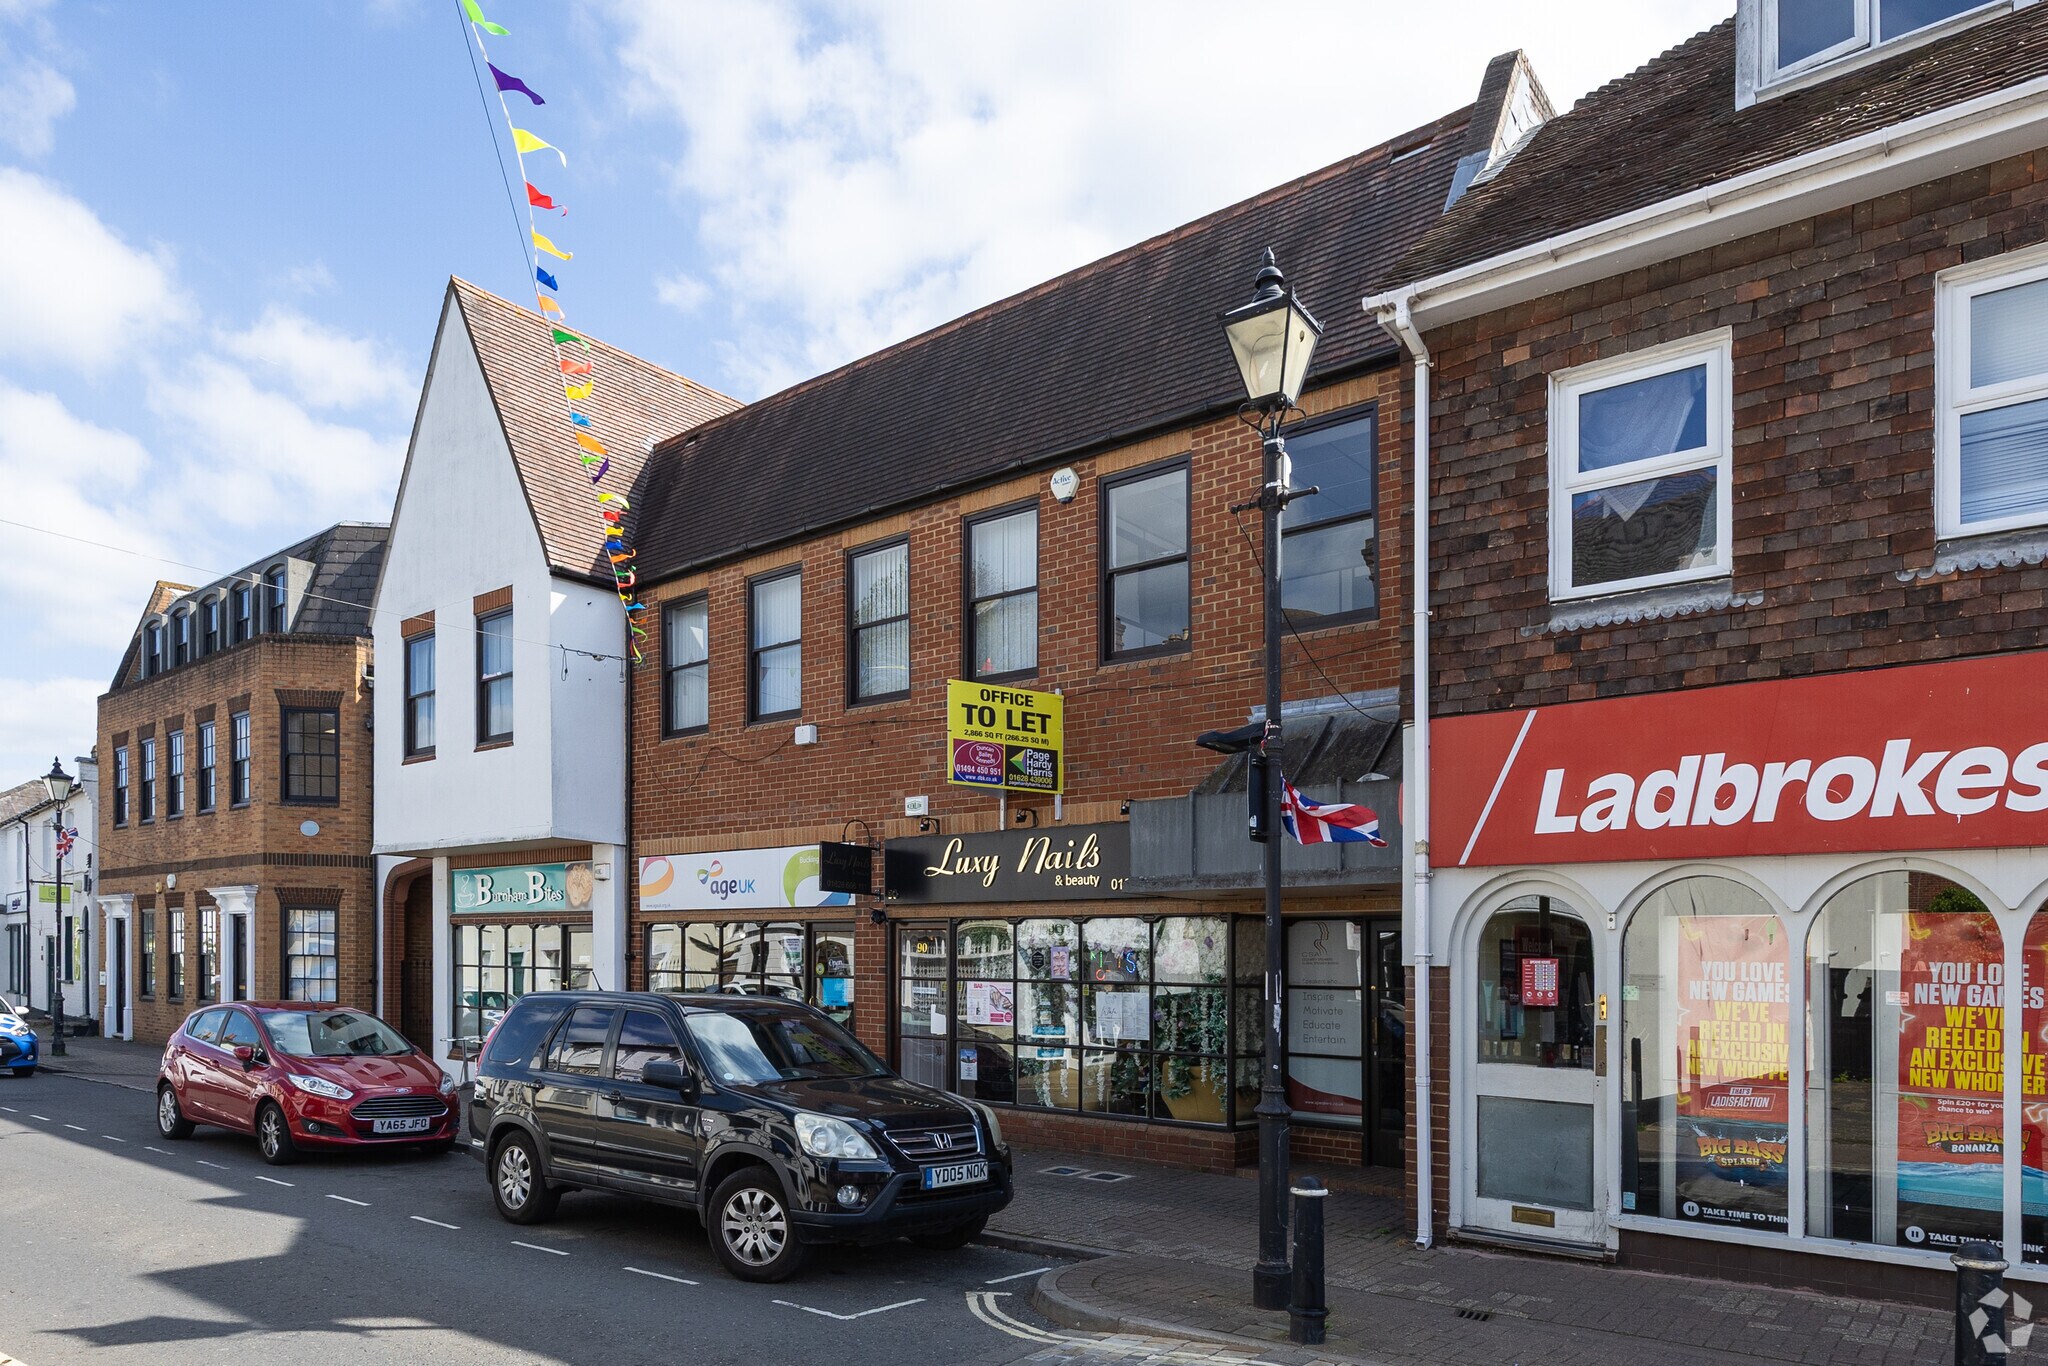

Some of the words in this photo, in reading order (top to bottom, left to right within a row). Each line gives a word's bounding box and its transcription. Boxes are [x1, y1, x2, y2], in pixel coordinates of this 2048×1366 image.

[980, 688, 1034, 708] OFFICE
[961, 703, 996, 728] TO
[1006, 709, 1051, 734] LET
[964, 729, 983, 738] 2,866
[984, 731, 994, 740] SQ
[995, 732, 1003, 740] FT
[1004, 734, 1029, 743] (266.25
[1030, 736, 1040, 745] SQ
[1040, 738, 1050, 746] M)
[976, 745, 995, 753] Duncan
[1026, 748, 1050, 761] Page
[956, 764, 975, 773] 01494
[976, 766, 988, 774] 450
[990, 768, 1001, 776] 951
[1026, 757, 1052, 771] Hardy
[1026, 767, 1053, 778] Harris
[1008, 774, 1028, 782] 01628
[1533, 738, 2048, 835] Ladbrokes
[923, 837, 1000, 888] Luxy
[1016, 833, 1101, 875] Nails
[473, 874, 528, 907] Burnham
[524, 871, 564, 906] Bites
[1054, 876, 1063, 886] &
[1066, 874, 1100, 888] beauty
[917, 942, 928, 953] 90
[1701, 960, 1736, 981] YOU
[1741, 962, 1785, 982] LOVE
[1929, 962, 1972, 984] YOU
[1977, 962, 2030, 986] LOE
[1302, 992, 1335, 1002] Inspire
[1689, 980, 1728, 1001] NEW
[1914, 983, 1961, 1006] NEW
[1966, 984, 2045, 1010] GAES
[1302, 1006, 1344, 1016] Motivate
[1714, 1000, 1770, 1022] WE'VE
[1302, 1020, 1341, 1030] Educate
[1700, 1020, 1762, 1042] REELED
[1766, 1023, 1785, 1044] IN
[1302, 1034, 1346, 1044] Entertain
[1926, 1026, 2000, 1052] REELED
[1686, 1039, 1708, 1058] AN
[1711, 1040, 1790, 1063] EXCLUSIV
[1685, 1057, 1718, 1076] NEW
[1722, 1059, 1788, 1081] WHOPPE
[1910, 1048, 1936, 1068] AN
[1940, 1050, 2046, 1076] EXCLUVE
[1909, 1068, 1949, 1088] NEW
[1953, 1070, 2046, 1095] WHOER
[1710, 1096, 1770, 1108] LADISFACTION
[1937, 1098, 1954, 1107] Spin
[1991, 1103, 2004, 1111] you
[380, 1120, 406, 1130] YA65
[1922, 1122, 1965, 1146] BIG
[1696, 1136, 1731, 1157] BIG
[1734, 1140, 1787, 1164] BASS
[1951, 1143, 2000, 1153] BONANZA
[1721, 1157, 1760, 1166] SPLASH
[935, 1166, 964, 1184] YD05
[966, 1162, 986, 1180] NOK
[1702, 1206, 1726, 1216] TAKE
[1728, 1210, 1750, 1220] TIME
[1752, 1213, 1766, 1221] TO
[1767, 1214, 1788, 1224] THIN
[1928, 1232, 1957, 1243] TAKE
[1989, 1240, 2004, 1248] TO
